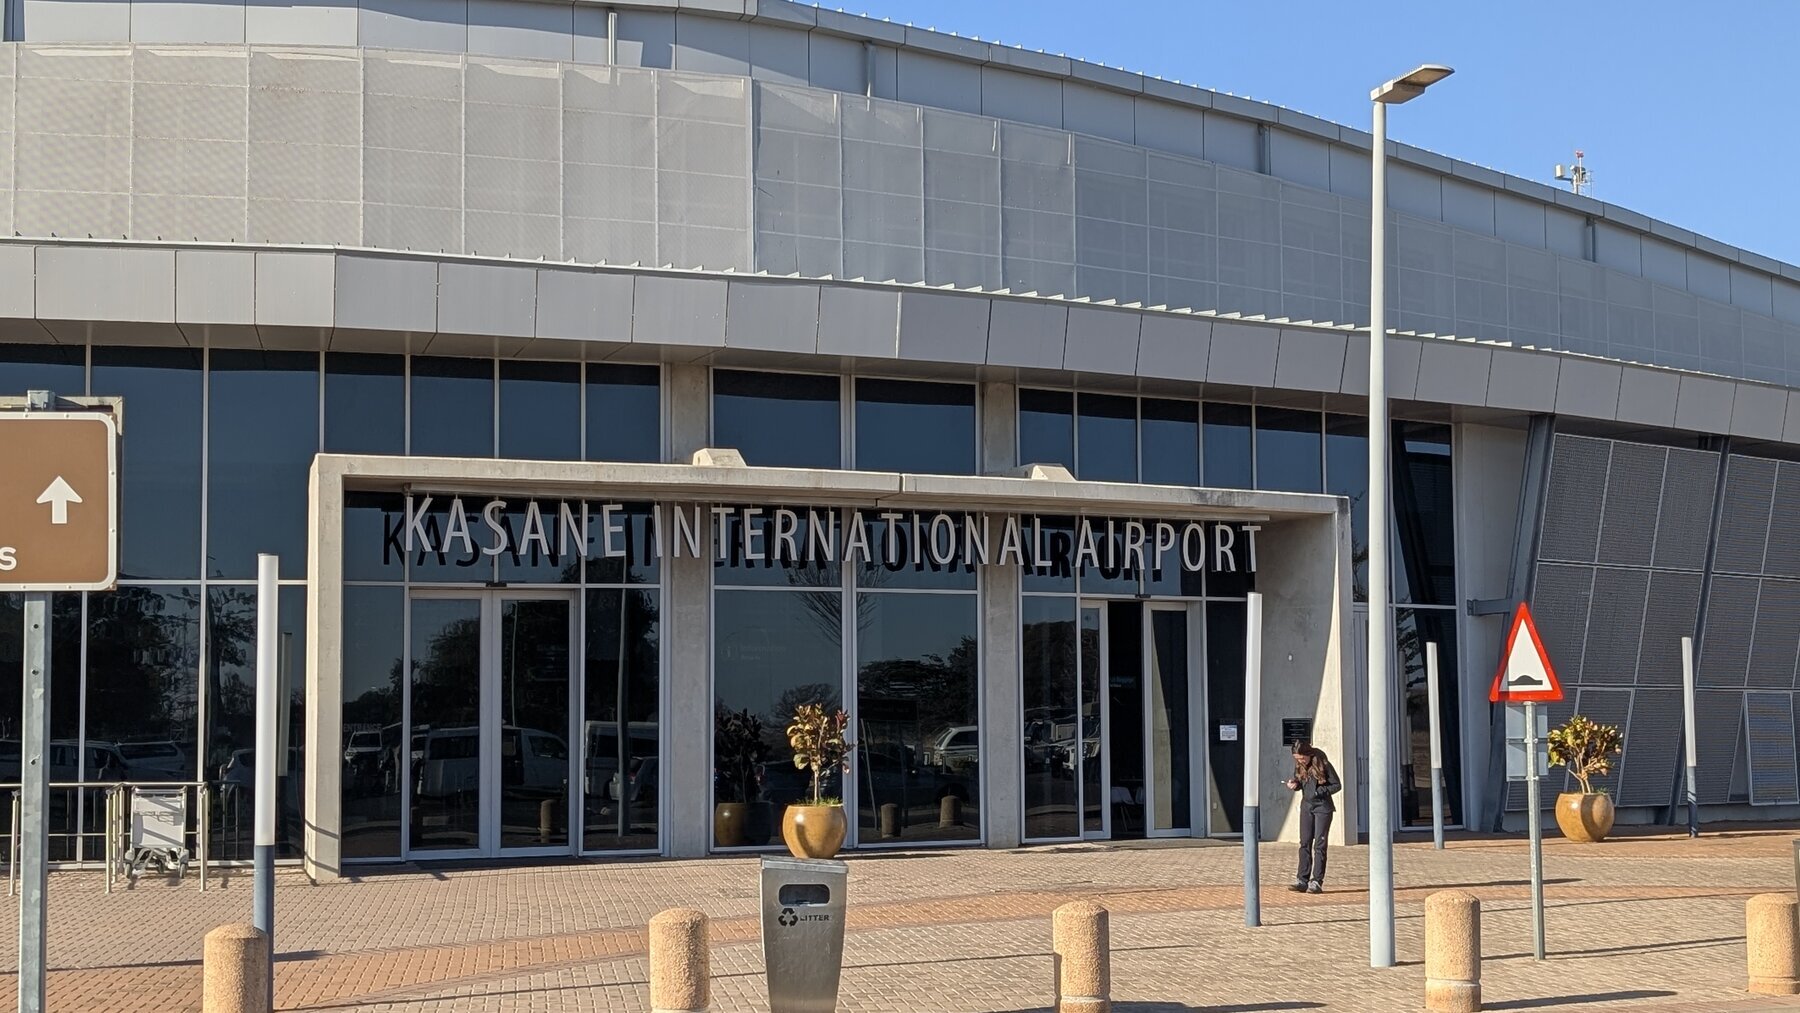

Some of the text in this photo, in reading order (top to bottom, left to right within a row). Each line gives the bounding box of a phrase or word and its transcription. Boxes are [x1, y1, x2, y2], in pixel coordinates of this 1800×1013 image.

[404, 496, 1262, 573] KASANE INTERNATIONAL AIRPORT
[800, 914, 830, 922] LITTER
